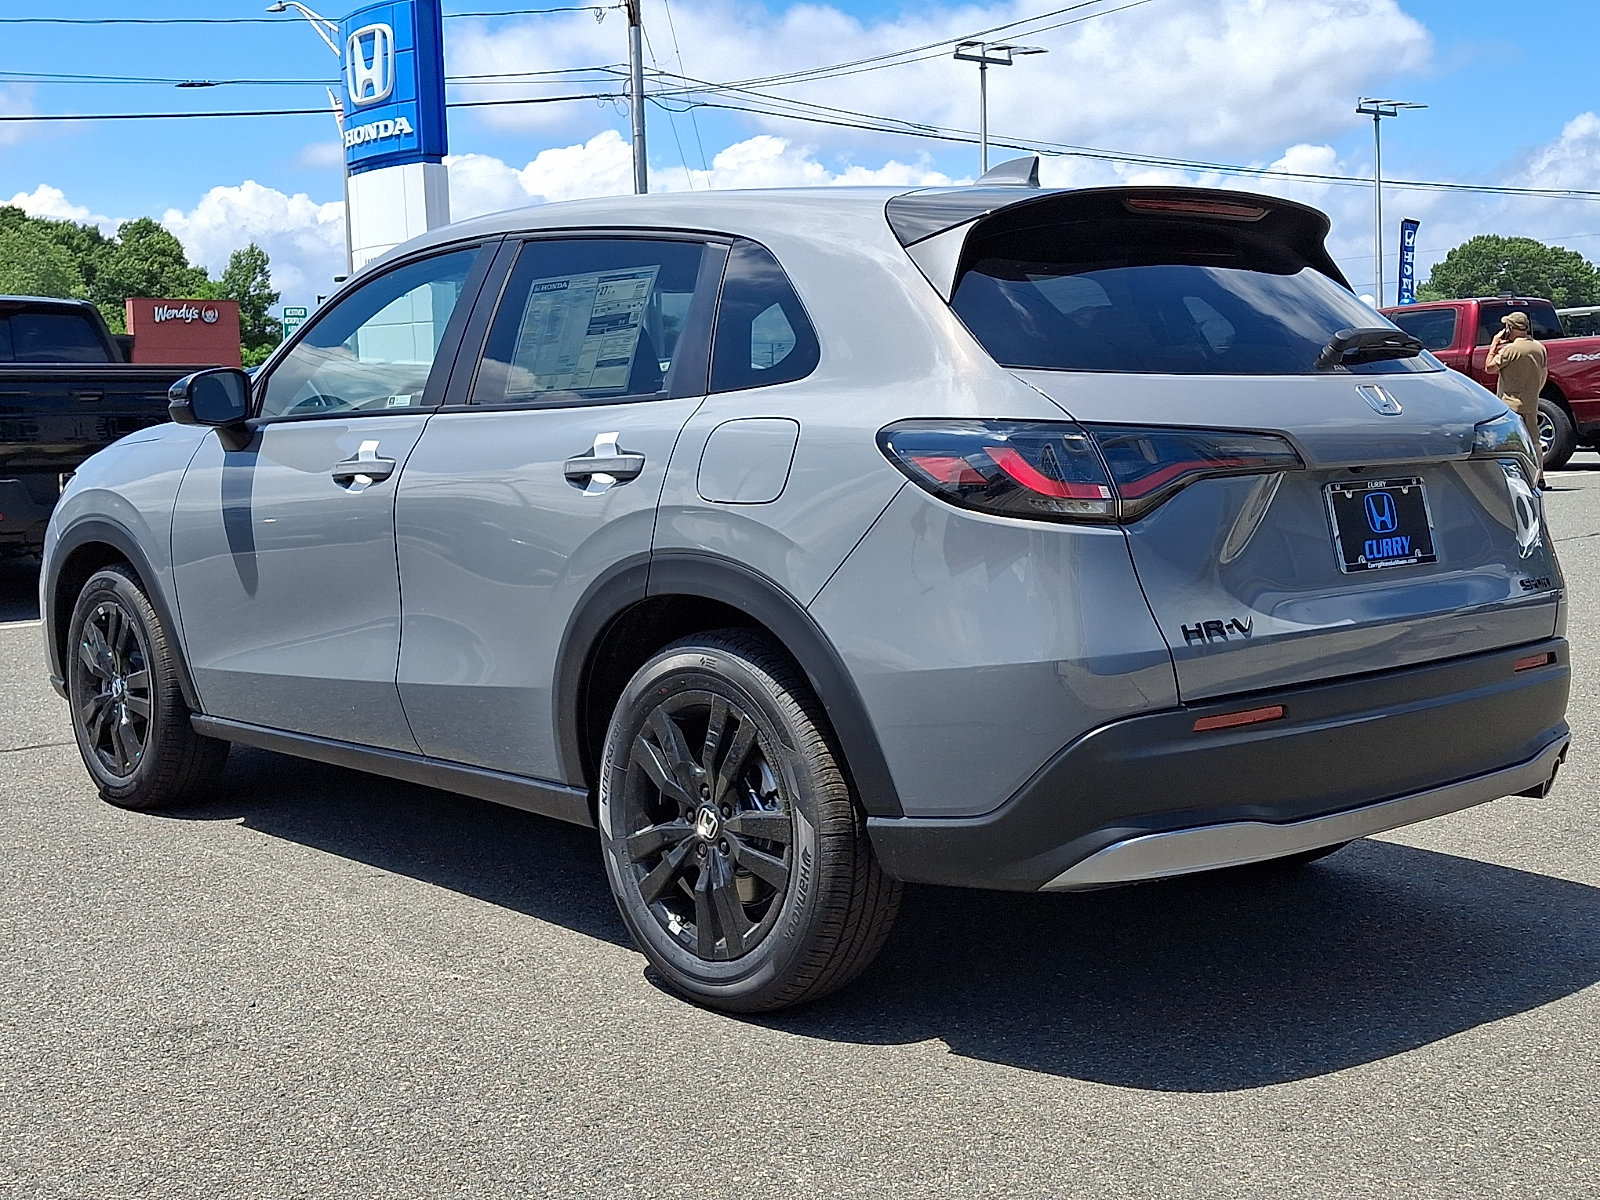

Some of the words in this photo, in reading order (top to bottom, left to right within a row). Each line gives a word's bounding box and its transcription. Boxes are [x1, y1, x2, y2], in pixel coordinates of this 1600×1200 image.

[344, 116, 414, 148] HONDA
[541, 281, 568, 291] HONDA
[154, 303, 199, 323] Wendy's
[1367, 481, 1387, 489] CURRY
[1365, 535, 1410, 559] CURRY
[1180, 615, 1253, 643] HR-V
